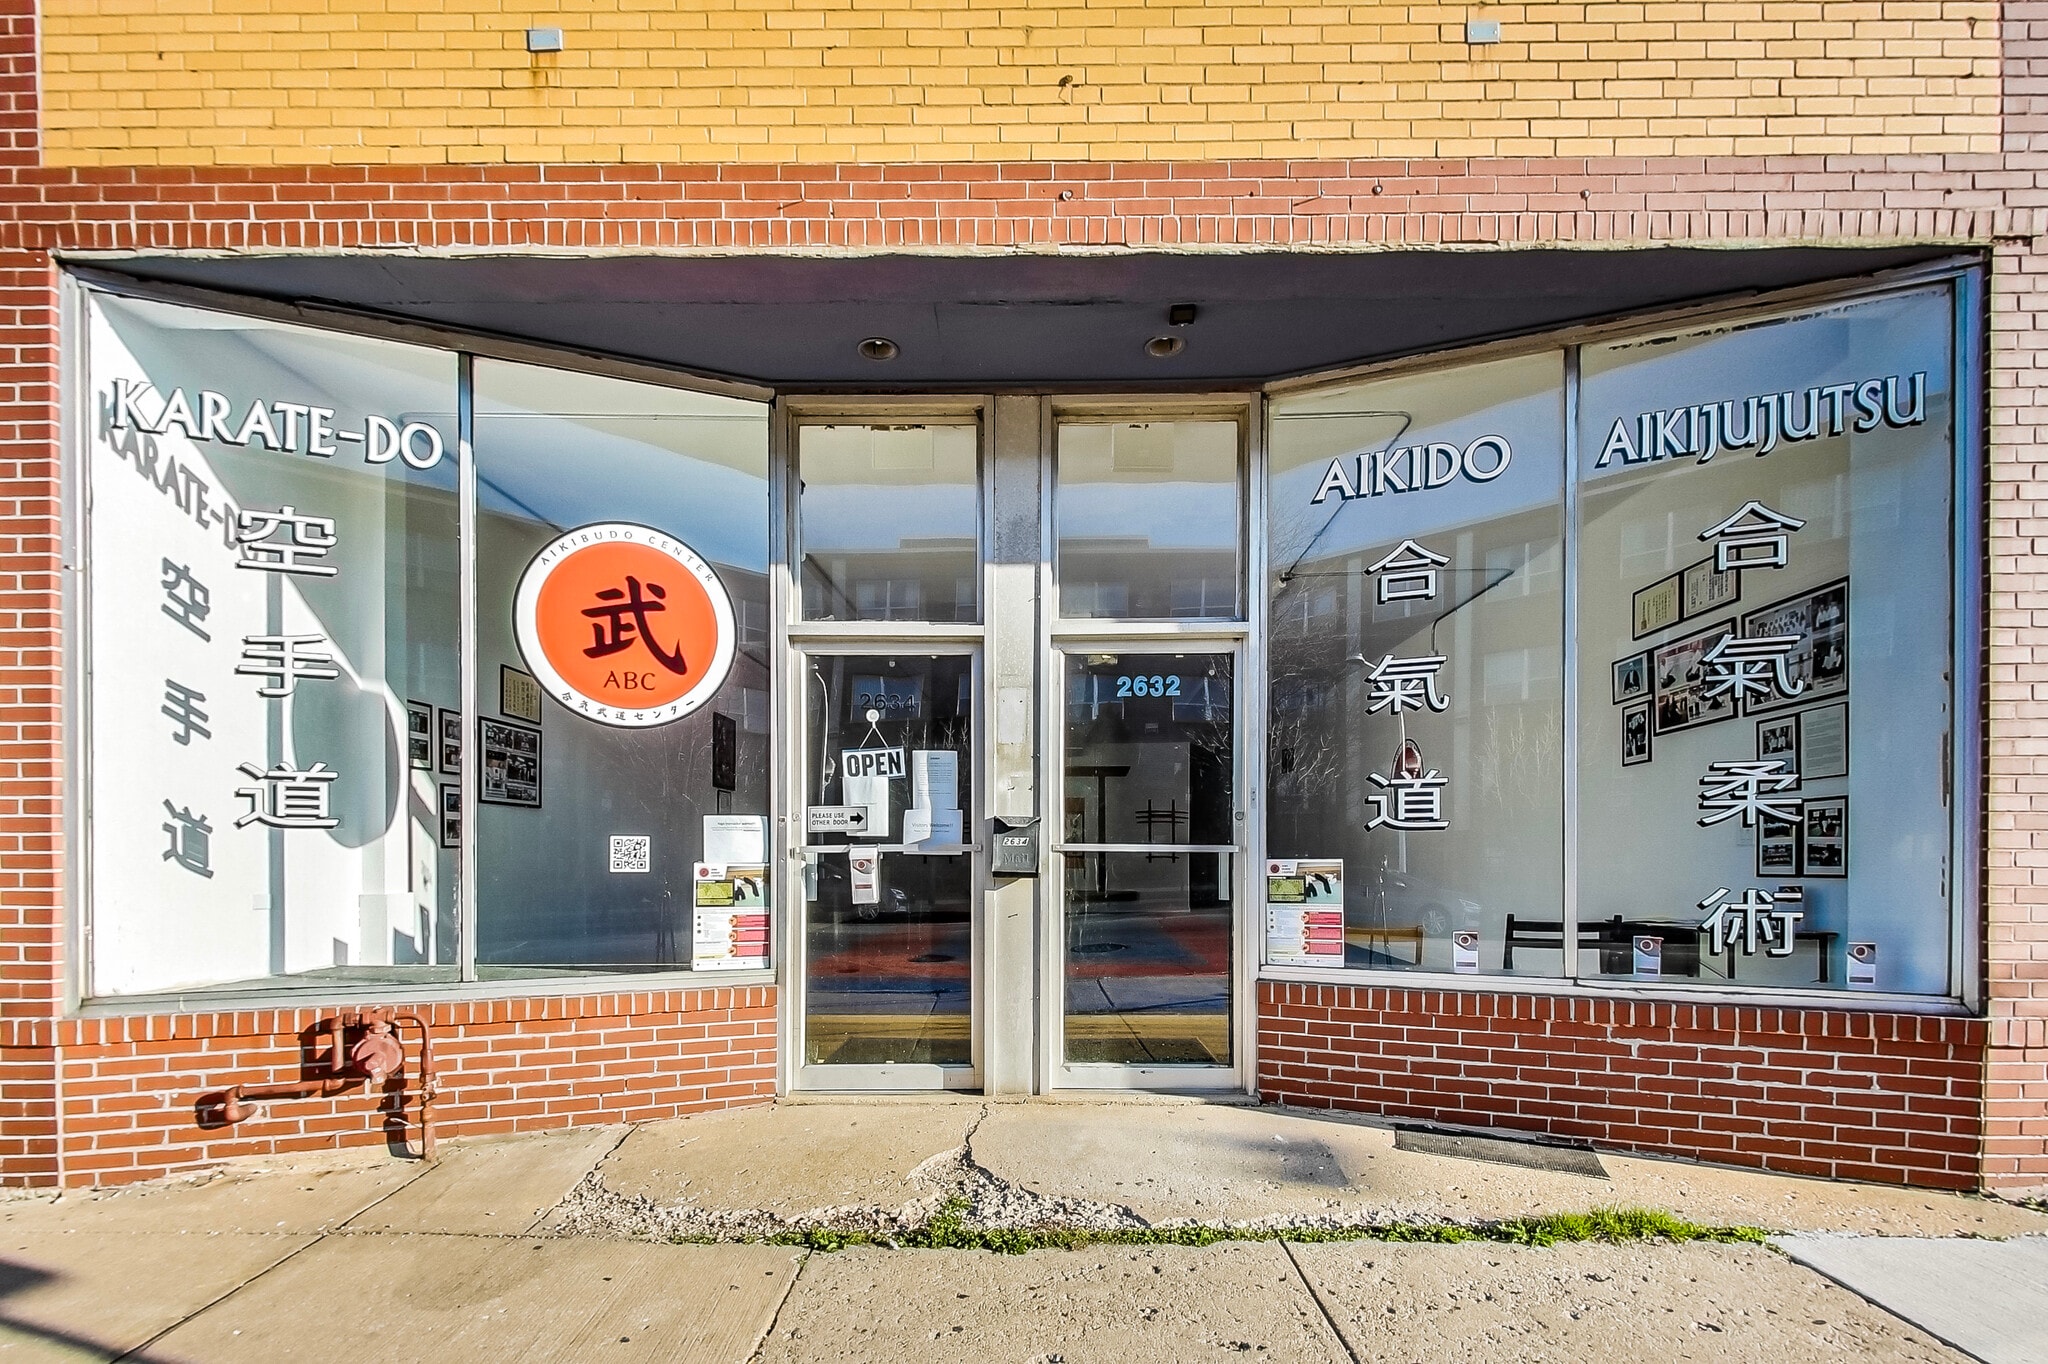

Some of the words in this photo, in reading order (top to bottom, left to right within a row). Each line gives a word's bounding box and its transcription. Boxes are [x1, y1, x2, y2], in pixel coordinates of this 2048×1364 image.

[111, 378, 444, 470] KARATE-DO
[1594, 371, 1927, 469] AIKIJUJUTSU
[1310, 434, 1512, 505] AIKIDO
[541, 530, 633, 566] AIKIBUDO
[648, 535, 714, 582] CENTER
[581, 575, 688, 676] 武
[234, 504, 341, 830] 空手道
[603, 670, 656, 691] ABC
[1116, 674, 1181, 698] 2632
[1364, 538, 1452, 832] 合氣道
[859, 692, 917, 712] 2634
[1696, 500, 1807, 957] 合氣柔術
[846, 751, 902, 778] OPEN
[1003, 837, 1028, 845] 2634
[1003, 853, 1029, 864] Mail
